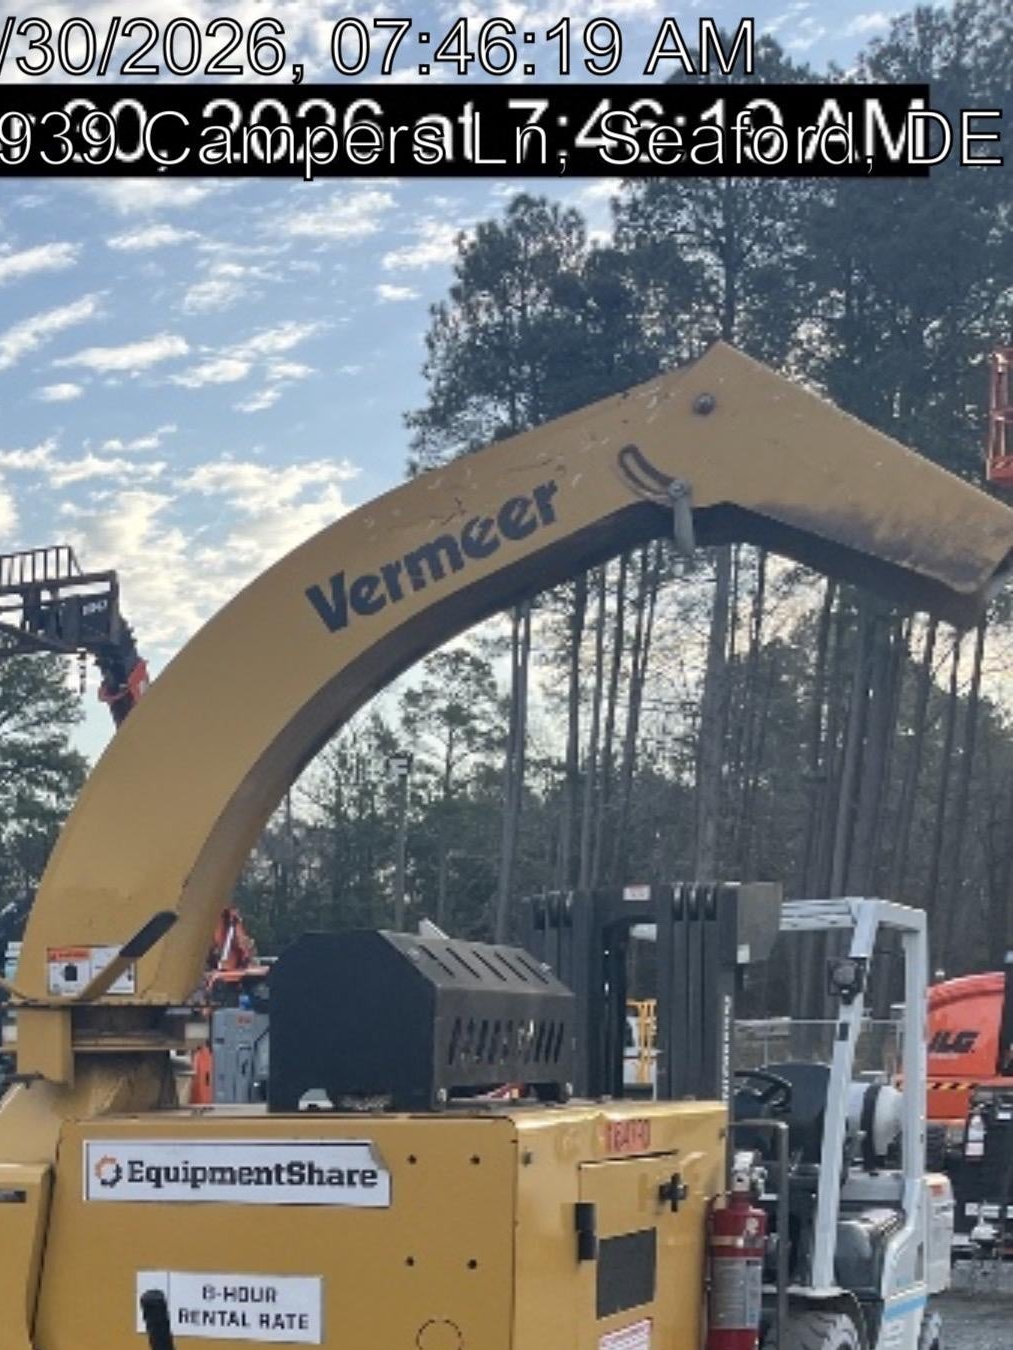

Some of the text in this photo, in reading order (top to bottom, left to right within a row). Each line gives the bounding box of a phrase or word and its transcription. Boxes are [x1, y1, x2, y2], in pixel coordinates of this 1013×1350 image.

[305, 479, 558, 633] Vermeer
[127, 1160, 379, 1188] EquipmentShare
[177, 1307, 310, 1331] RENTAL RATE
